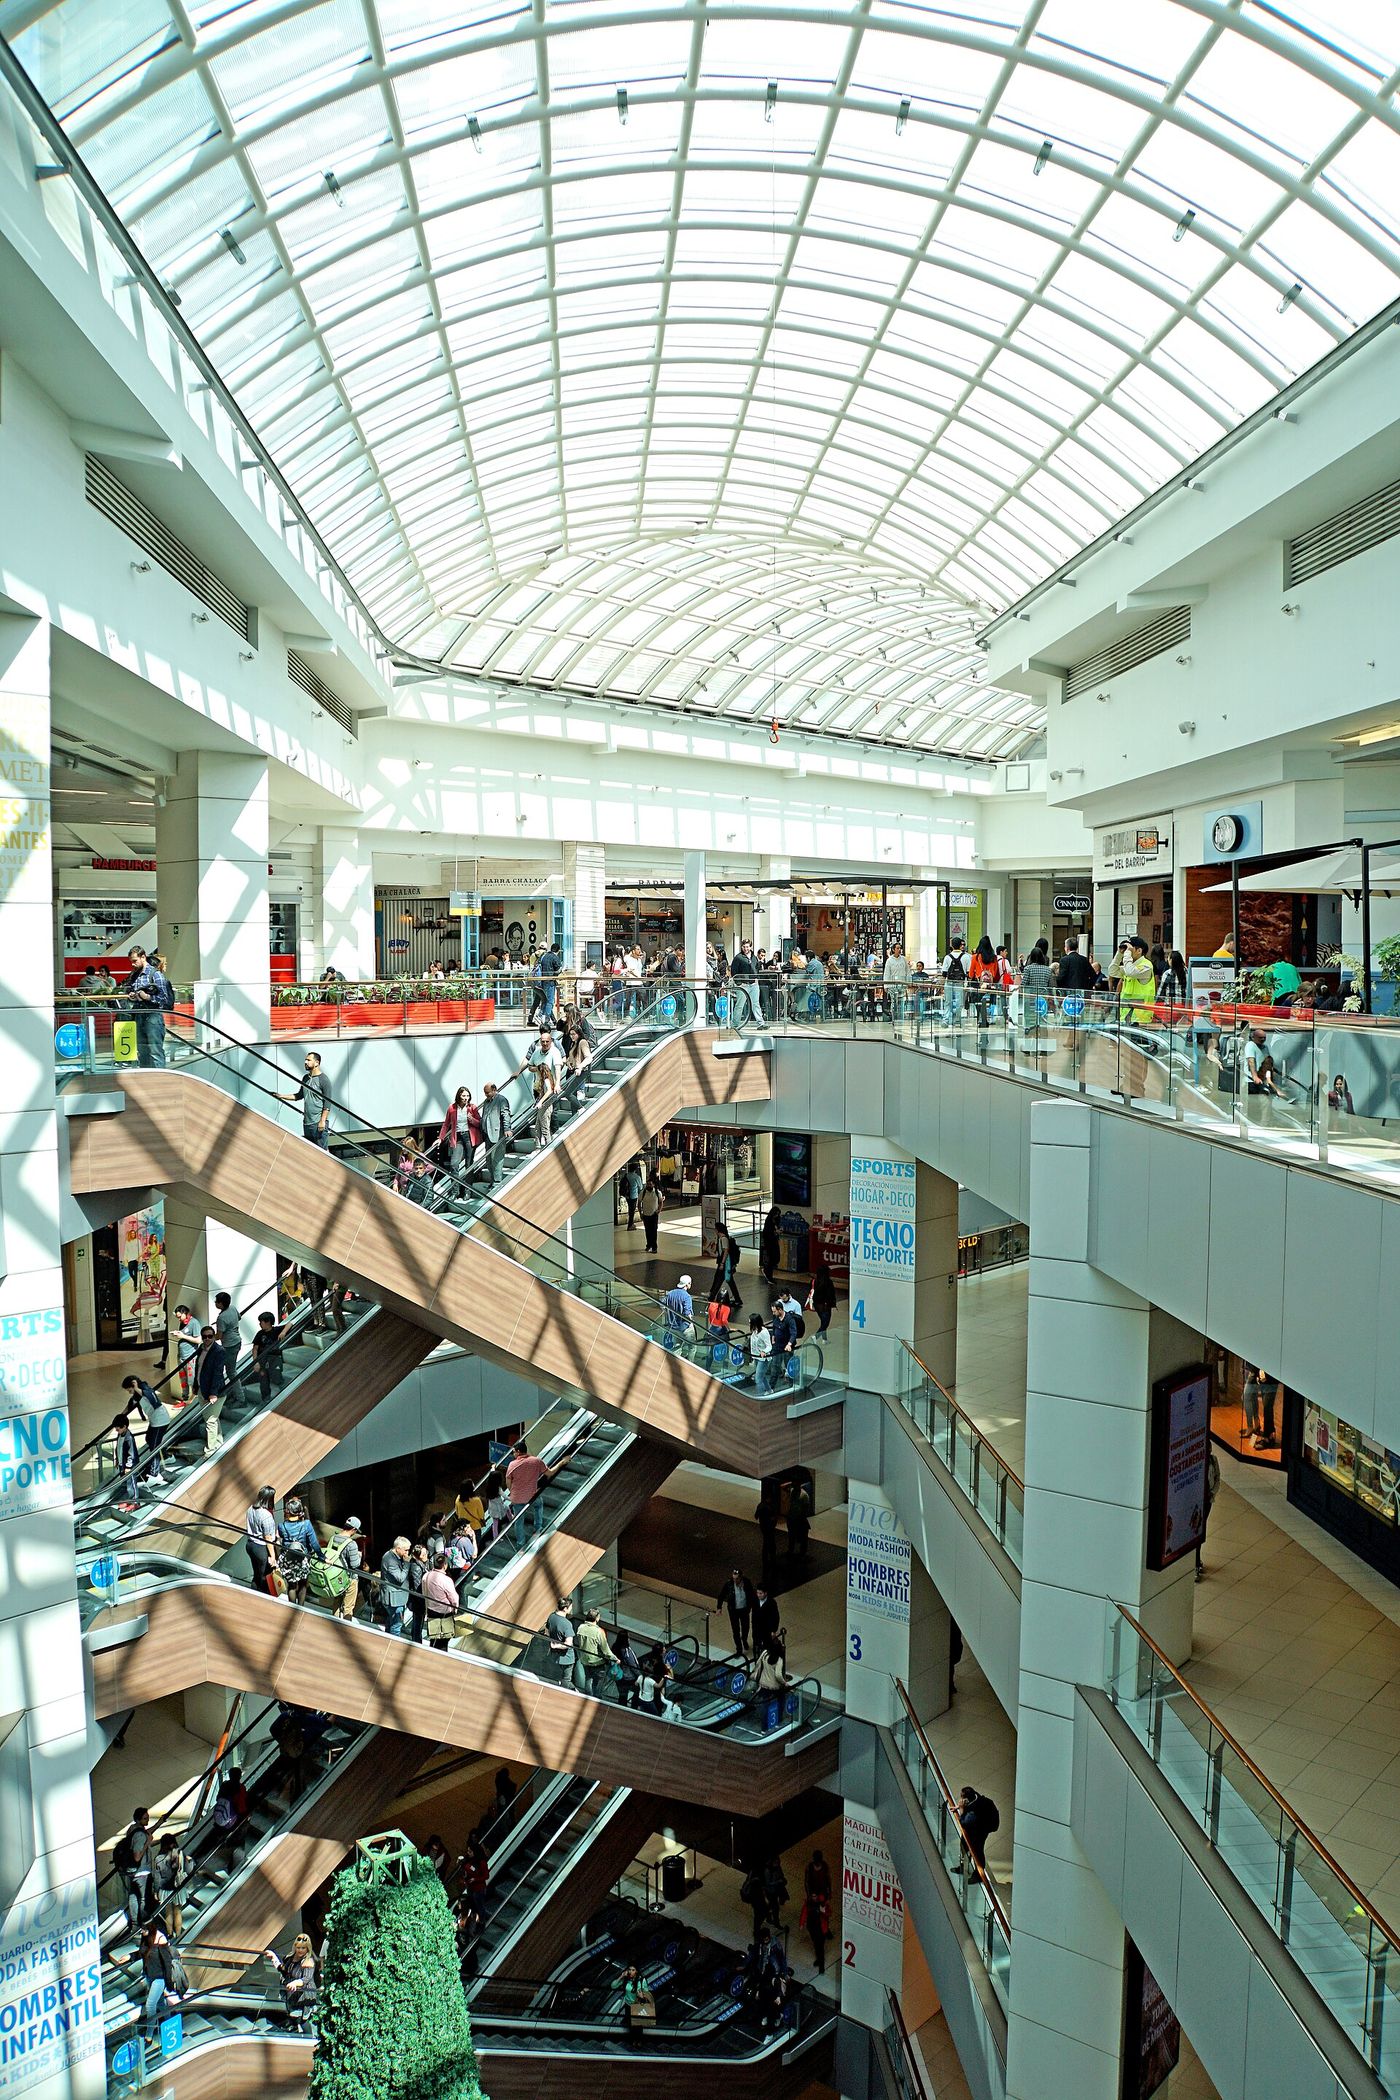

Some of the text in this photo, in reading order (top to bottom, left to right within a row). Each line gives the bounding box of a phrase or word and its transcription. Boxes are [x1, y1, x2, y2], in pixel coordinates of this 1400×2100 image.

[1115, 856, 1146, 869] DEL BARRIO
[389, 888, 421, 897] CHALACA
[1056, 899, 1088, 908] CINNABON
[120, 1036, 131, 1056] 5
[852, 1158, 915, 1178] SPORTS
[851, 1187, 915, 1208] HOGAR DECO
[852, 1179, 890, 1189] DECORACIÓN
[851, 1217, 914, 1249] TECNO
[823, 1250, 850, 1264] turi
[851, 1242, 914, 1266] Y DEPORTE
[1, 1309, 62, 1340] RTS
[852, 1300, 866, 1328] 4
[19, 1357, 64, 1388] DECO
[2, 1453, 71, 1492] PORTE
[849, 1533, 910, 1559] MODA FASHION
[880, 1533, 910, 1547] CALZADO
[849, 1556, 910, 1588] HOMBRES
[849, 1573, 854, 1587] E
[858, 1575, 909, 1604] INFANTIL
[862, 1594, 882, 1609] KIDS
[889, 1601, 909, 1617] KIDS
[850, 1634, 862, 1661] 3
[770, 1712, 776, 1726] 3
[845, 1818, 886, 1841] MAQUILL
[845, 1836, 890, 1861] CARTERAS
[844, 1868, 904, 1912] MUJER
[844, 1897, 903, 1931] FASHION
[40, 1913, 95, 1944] CALZADO
[31, 1925, 97, 1969] FASHION
[844, 1941, 856, 1968] 2
[0, 1964, 100, 2034] OMBRES
[2, 1995, 102, 2064] INFANTIL
[166, 2030, 177, 2049] 3
[11, 2052, 50, 2084] KIDS
[62, 2042, 103, 2069] JUGUETES
